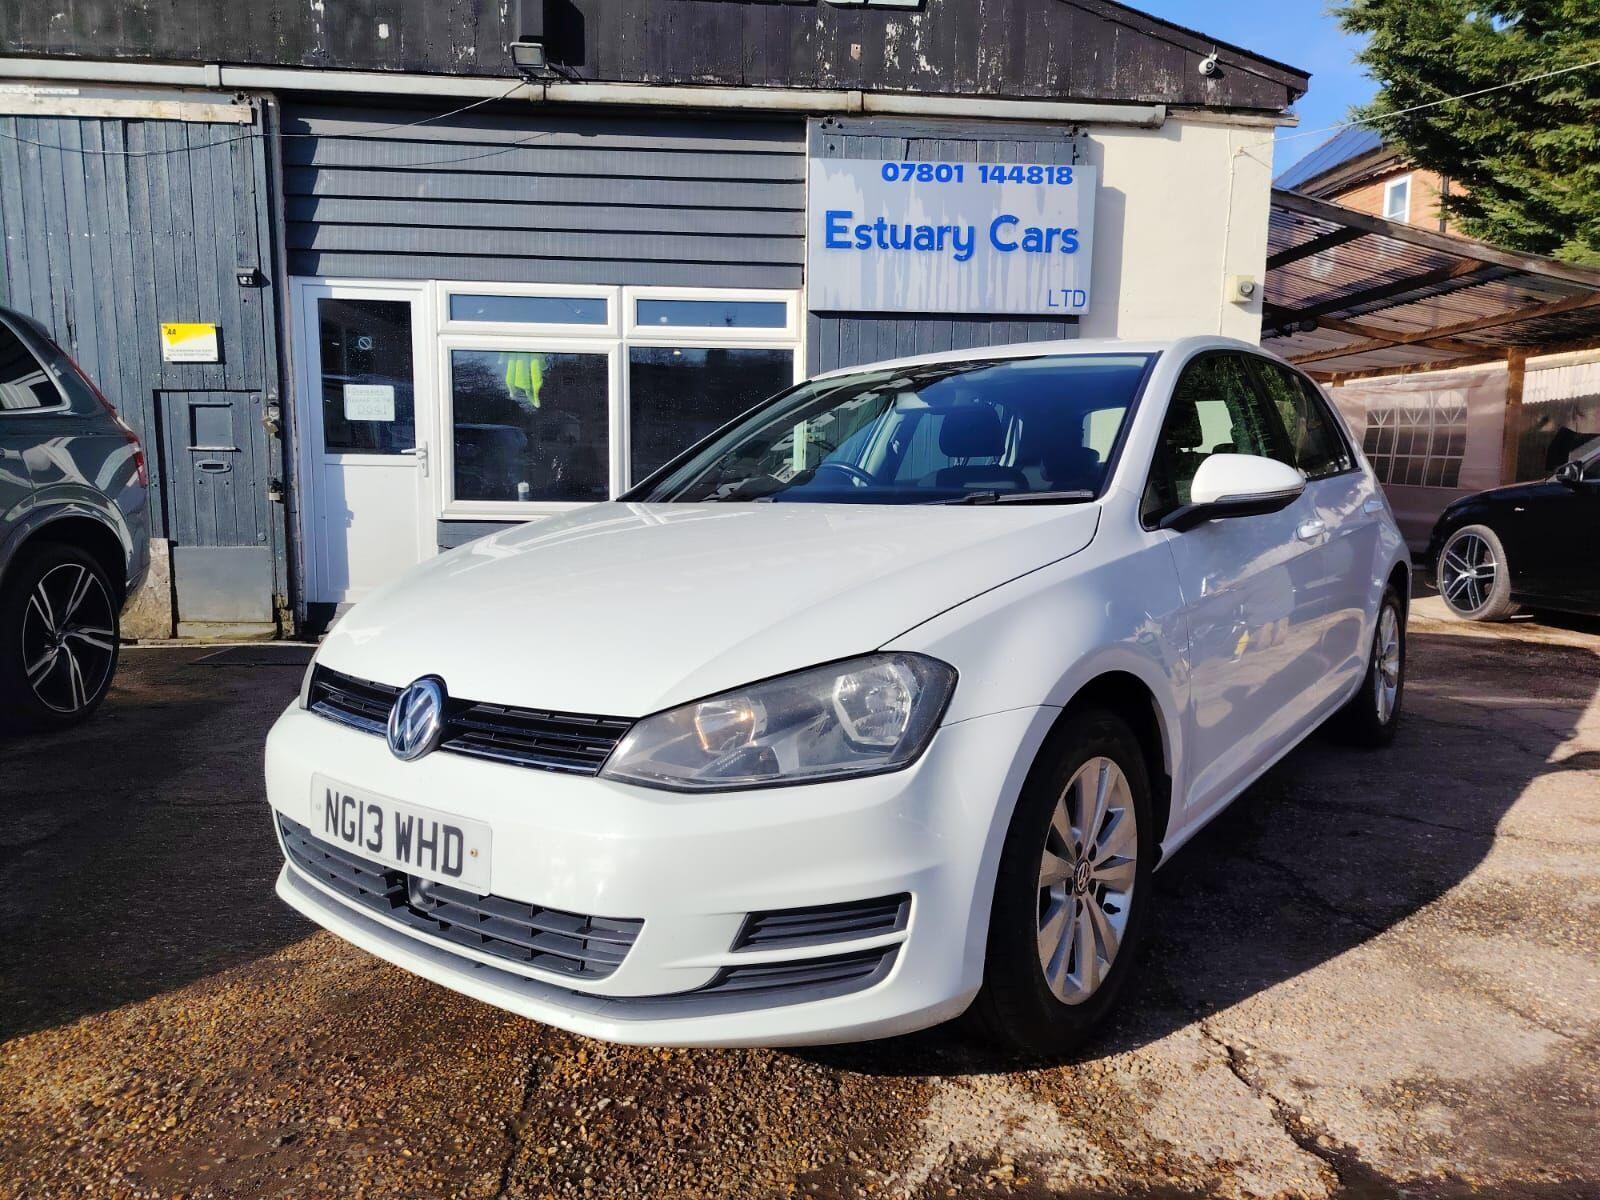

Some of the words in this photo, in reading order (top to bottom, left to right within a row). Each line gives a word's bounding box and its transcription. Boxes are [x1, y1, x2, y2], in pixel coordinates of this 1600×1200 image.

[882, 163, 963, 182] 07801
[979, 165, 1073, 185] 144818
[825, 210, 974, 262] Estuary
[989, 214, 1079, 254] Cars
[1048, 289, 1086, 307] LTD
[325, 788, 383, 853] NG13
[395, 811, 464, 878] WHD
